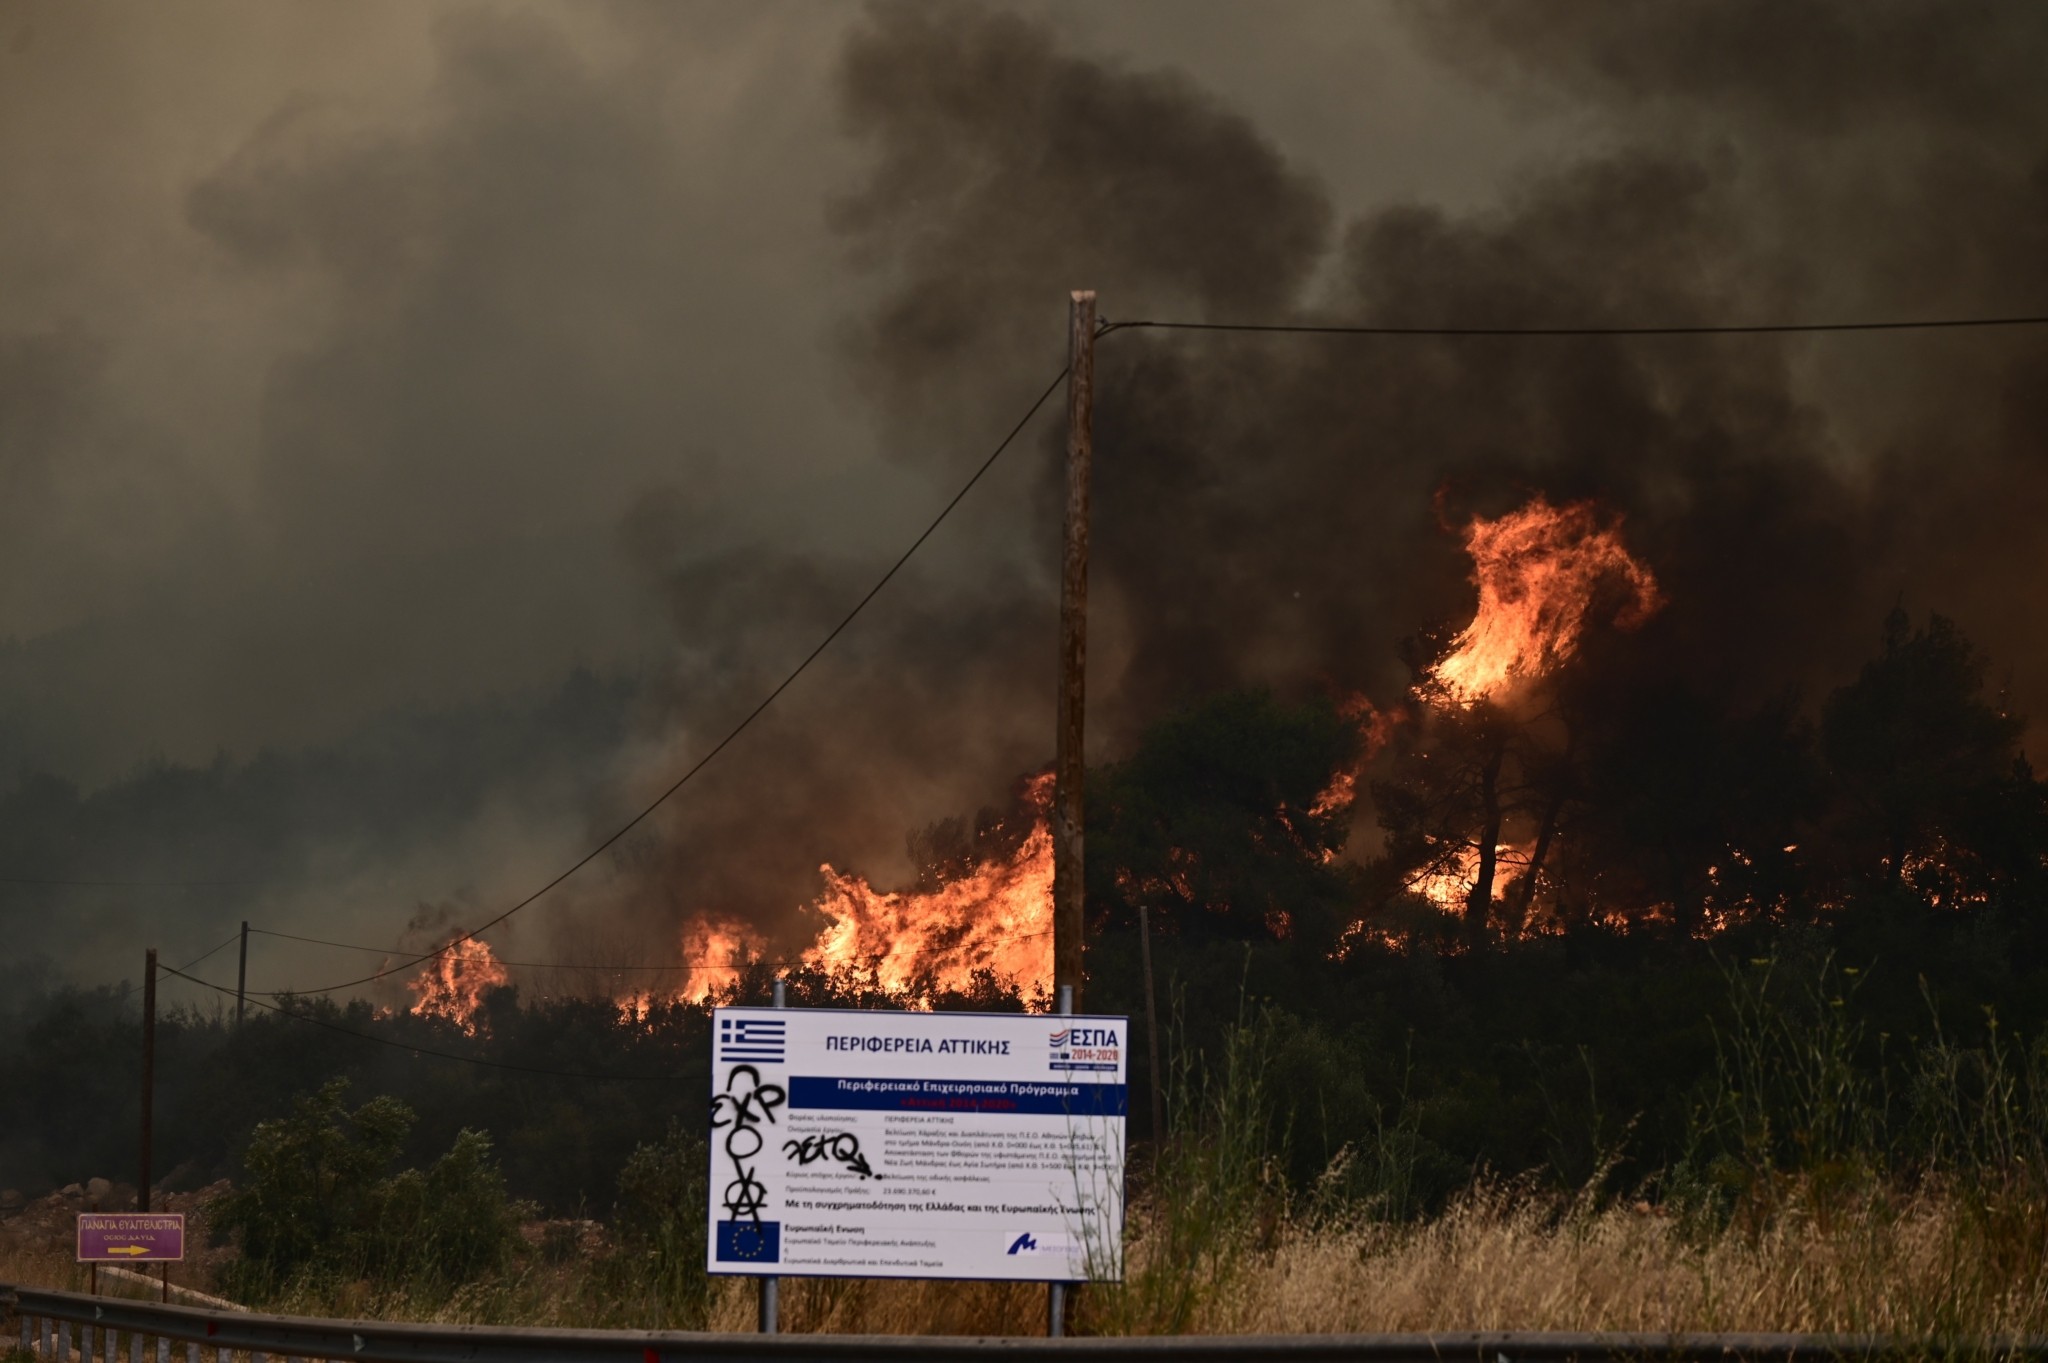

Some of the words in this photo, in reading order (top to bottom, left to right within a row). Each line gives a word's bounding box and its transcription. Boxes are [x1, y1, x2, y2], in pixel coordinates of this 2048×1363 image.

[826, 1036, 933, 1053] ΠΕΡΙΦΕΡΕΙΑ
[938, 1038, 1011, 1055] ΑΤΤΙΚΗΣ
[1071, 1029, 1118, 1046] ΕΣΠΑ
[1072, 1049, 1118, 1061] 2014-2020
[837, 1080, 920, 1093] Περιφερειακό
[923, 1081, 1007, 1095] Επιχειρησιακό
[1010, 1084, 1079, 1096] Πρόγραμμα
[785, 1199, 799, 1208] Με
[803, 1201, 813, 1210] τη
[815, 1201, 906, 1212] συγχρηματοδότηση
[909, 1204, 924, 1212] της
[926, 1202, 965, 1213] Ελλάδας
[985, 1205, 1000, 1213] της
[1002, 1204, 1058, 1215] Ευρωπαϊκής
[81, 1219, 118, 1230] ΠΑΝΑΓΙΑ
[785, 1224, 834, 1234] Ευρωπαϊκή
